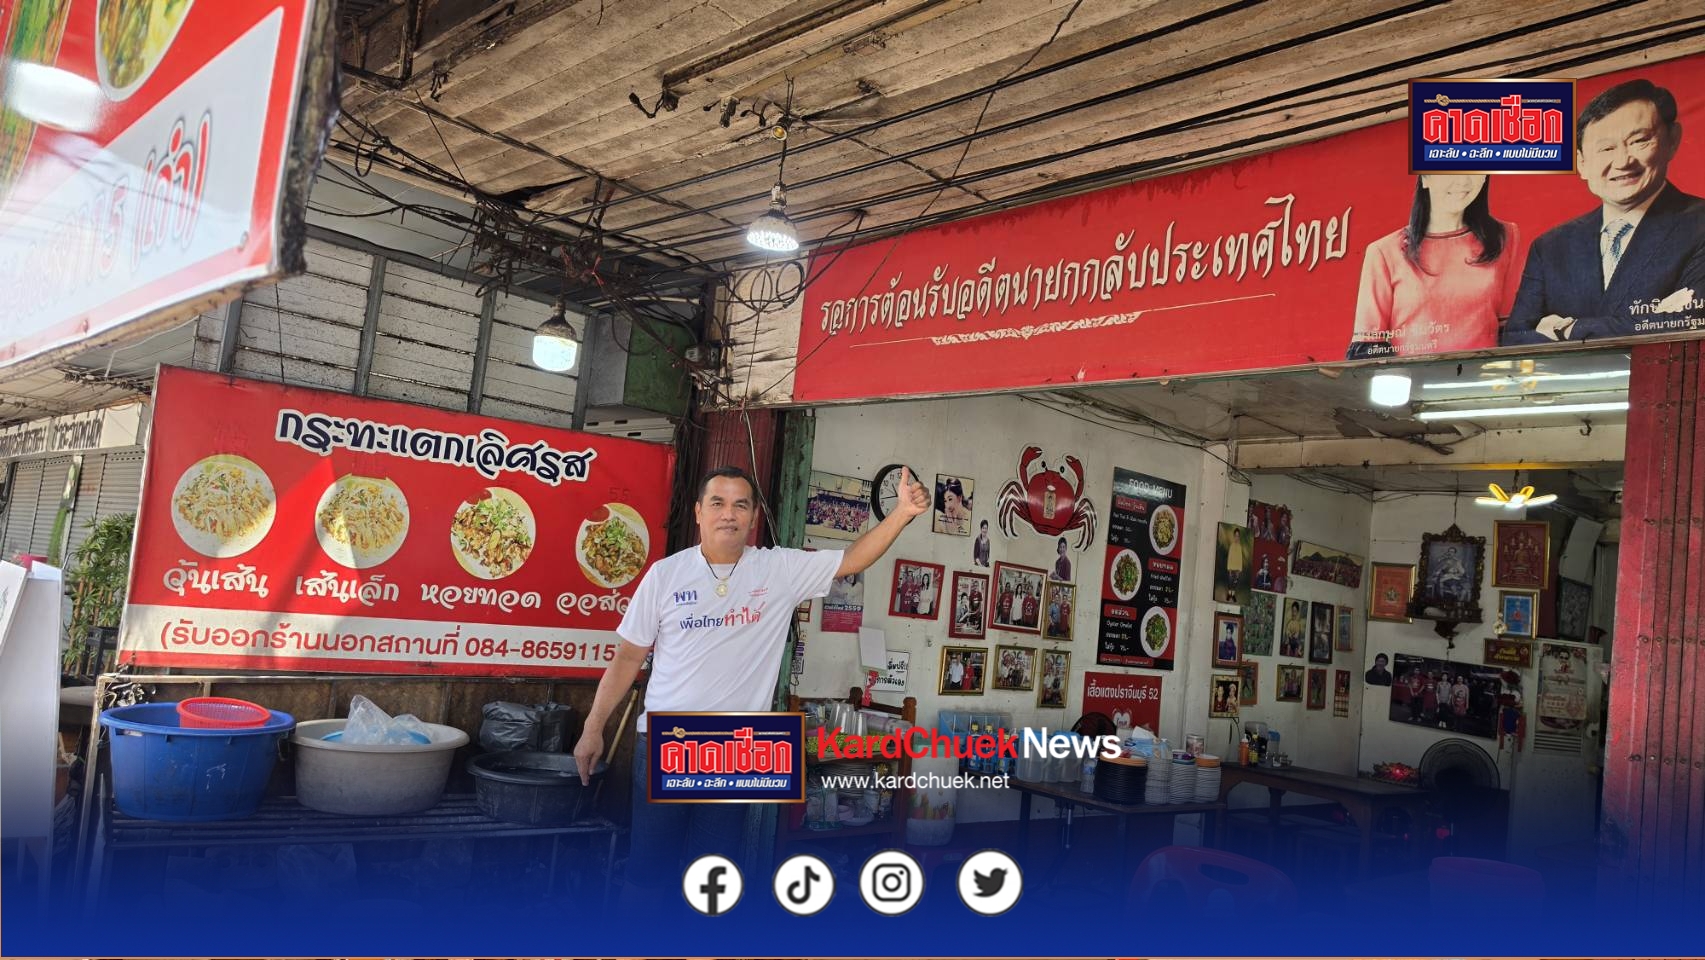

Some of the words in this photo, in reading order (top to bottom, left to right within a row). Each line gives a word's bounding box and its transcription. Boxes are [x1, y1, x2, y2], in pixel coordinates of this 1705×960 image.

[820, 193, 1353, 336] รอการต้อนรับอดีตนายกกลับประเทศไทย
[277, 410, 597, 485] กระทะแตกเลิศรส
[296, 570, 400, 606] เส้นเล็ก
[421, 583, 542, 614] หอยทอด
[556, 588, 632, 616] ออส่ว
[673, 589, 698, 603] พท
[160, 618, 461, 655] (รับออกร้านนอกสถานที่
[465, 637, 621, 661] 084-8659115
[1087, 679, 1148, 703] เสื้อแดงปราจีนบุรี
[1148, 687, 1159, 700] 52
